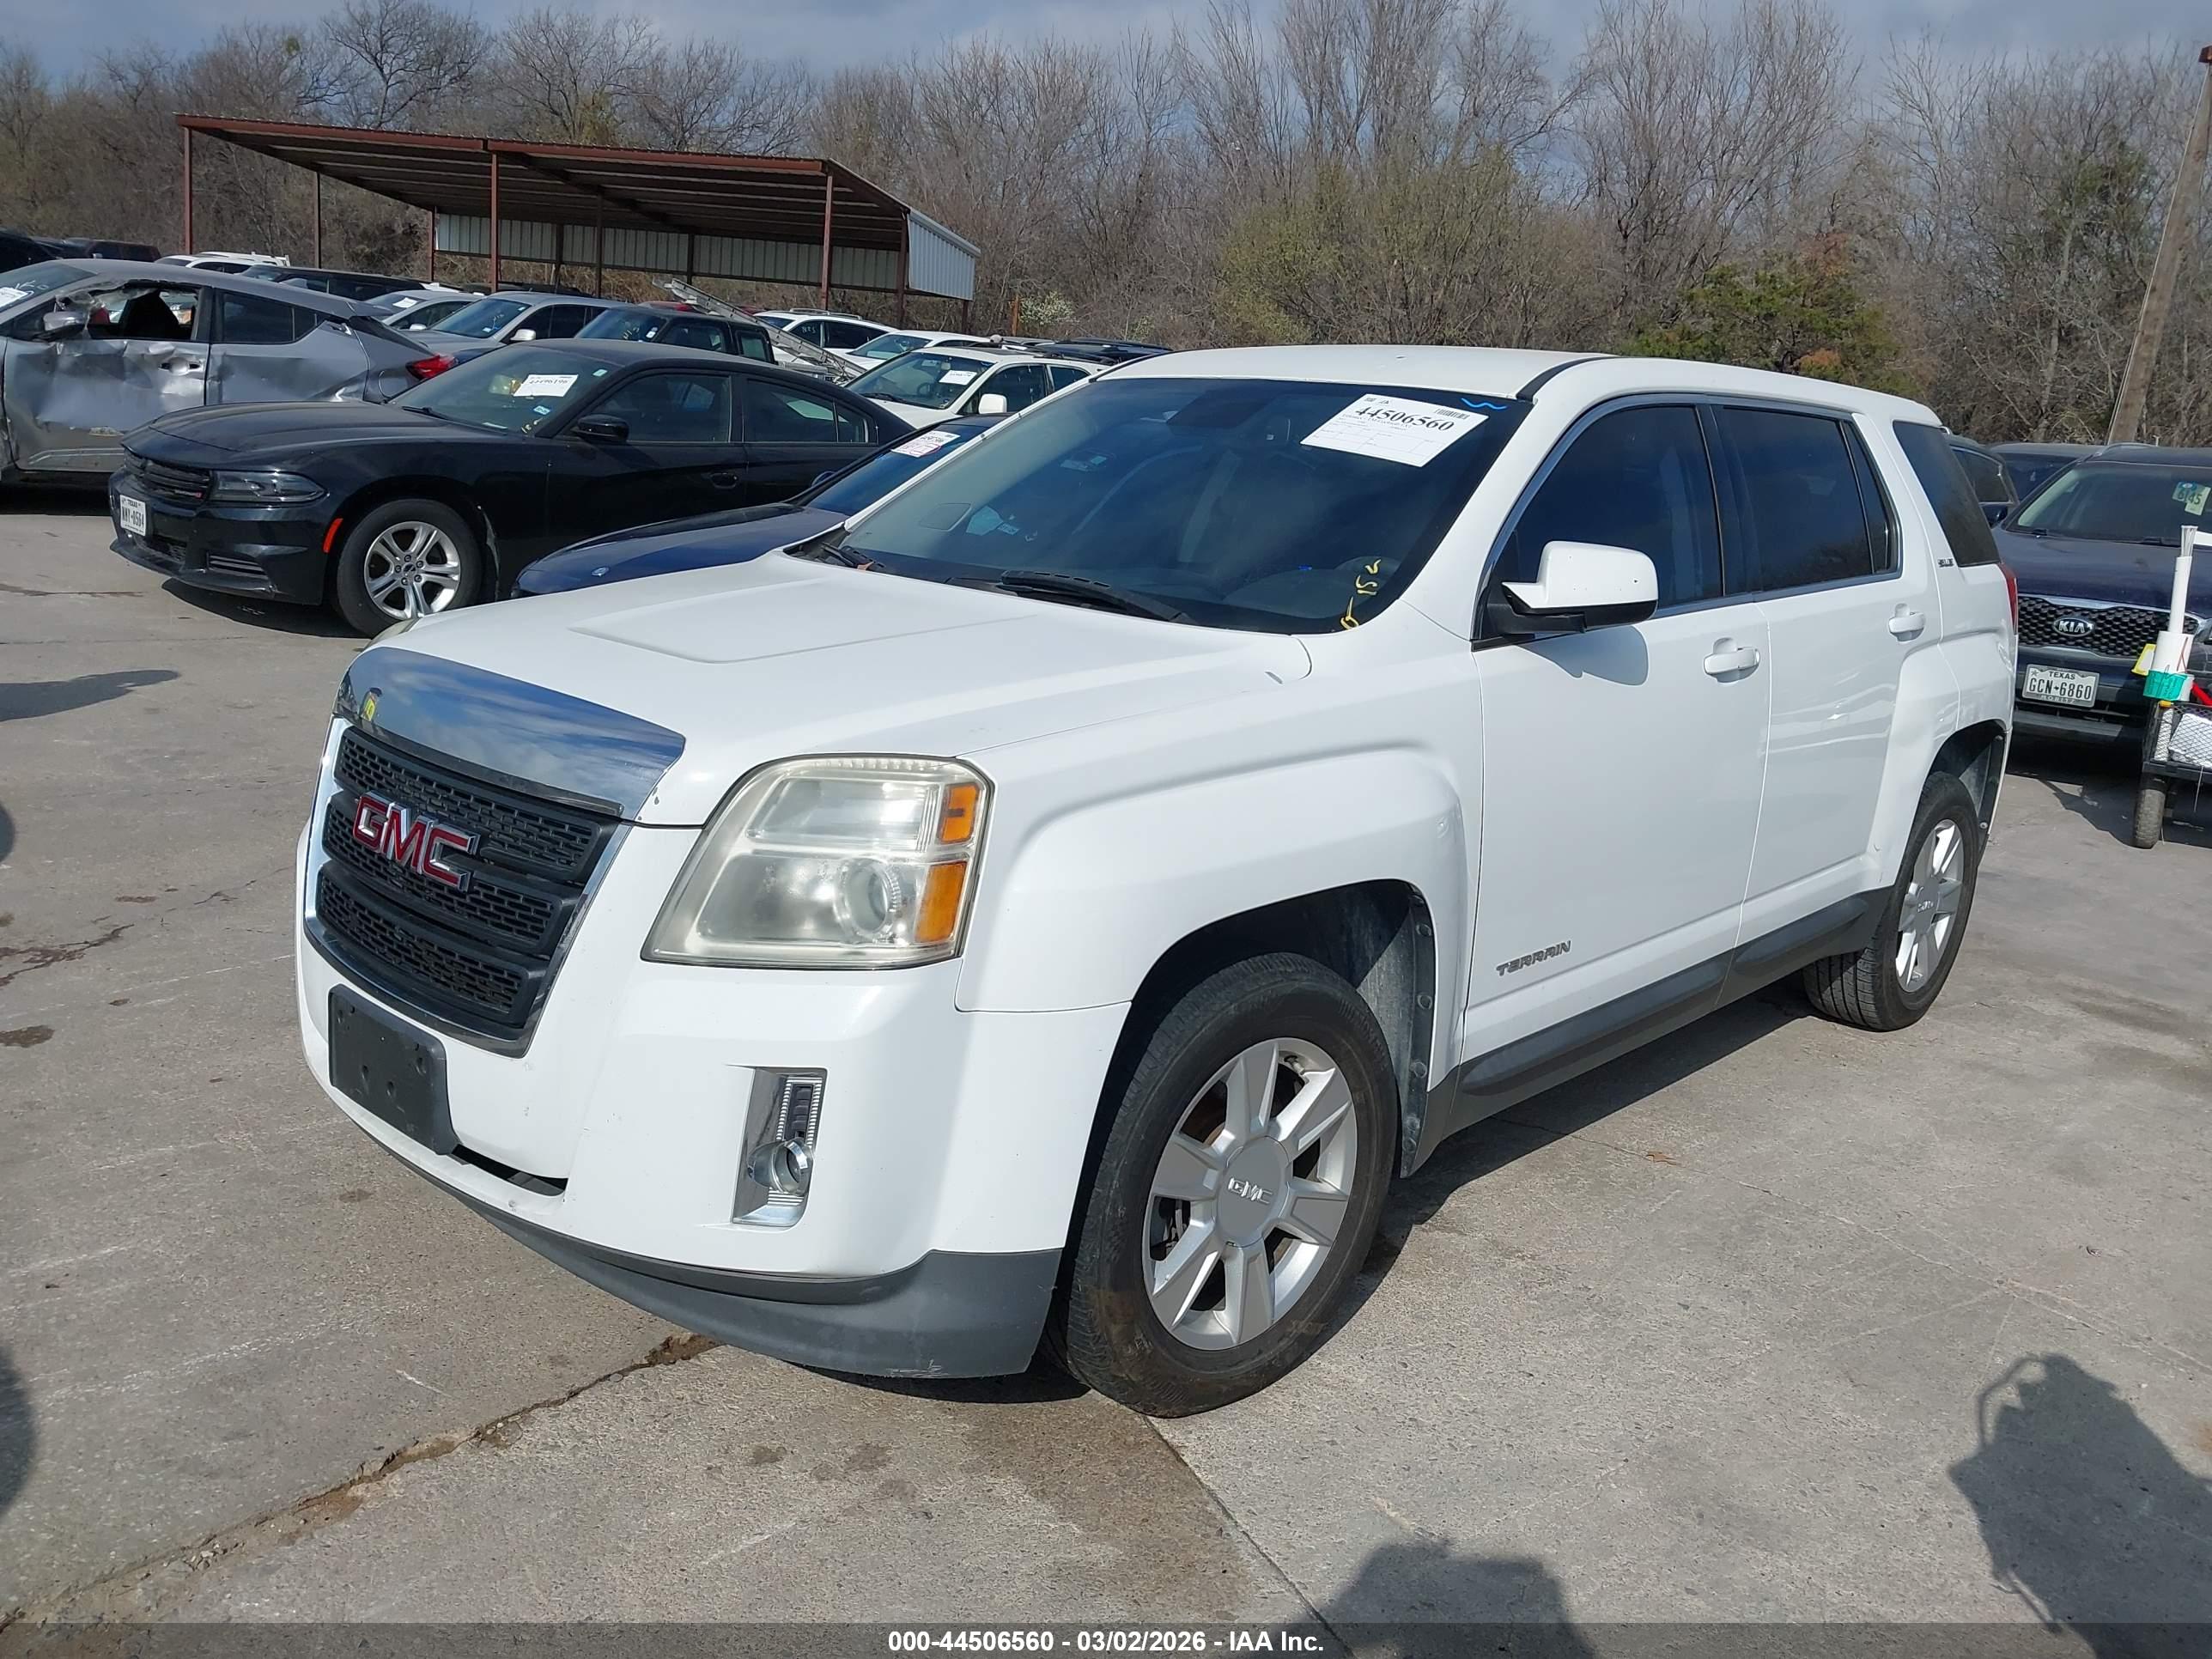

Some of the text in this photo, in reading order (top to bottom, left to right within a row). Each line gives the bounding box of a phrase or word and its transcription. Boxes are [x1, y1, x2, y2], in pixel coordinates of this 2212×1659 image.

[1355, 406, 1455, 431] 44506560
[2058, 620, 2086, 634] KIA
[2048, 671, 2075, 680] TEXAS
[353, 790, 481, 892] GMC
[1496, 939, 1571, 976] TERRAIN
[1228, 1177, 1273, 1204] GMC
